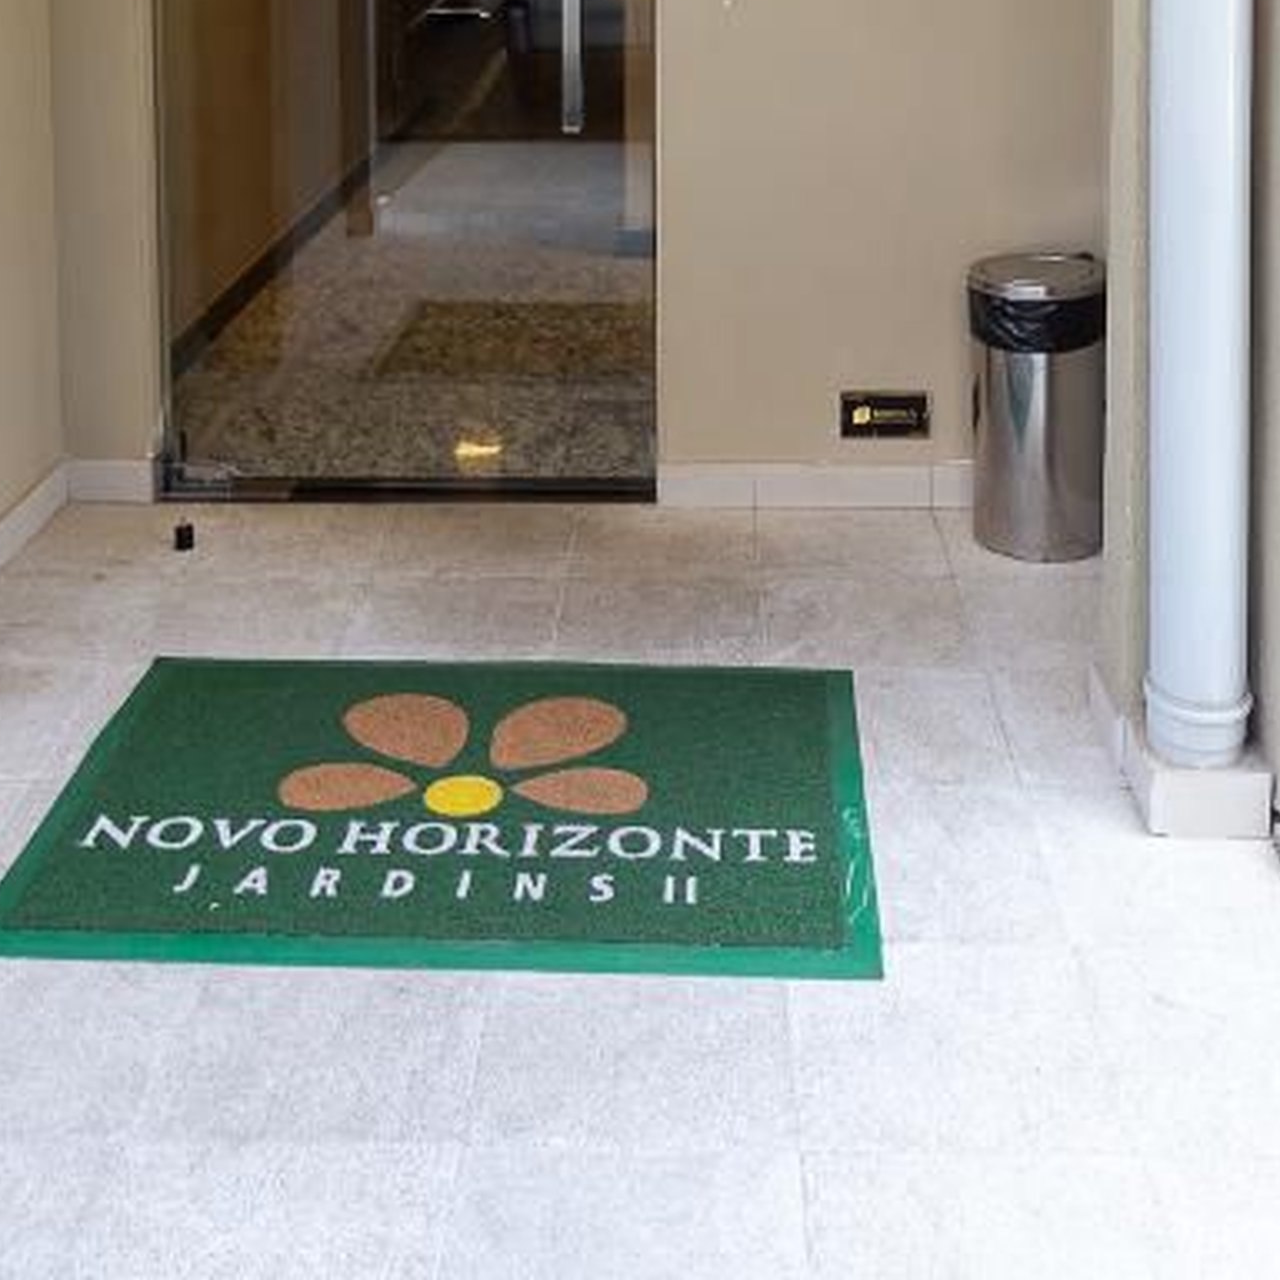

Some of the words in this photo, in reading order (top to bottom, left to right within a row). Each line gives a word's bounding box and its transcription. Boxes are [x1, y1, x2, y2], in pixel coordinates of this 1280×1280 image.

[79, 813, 318, 853] NOVO
[336, 820, 817, 862] HORIZONTE
[172, 863, 616, 903] JARDINS
